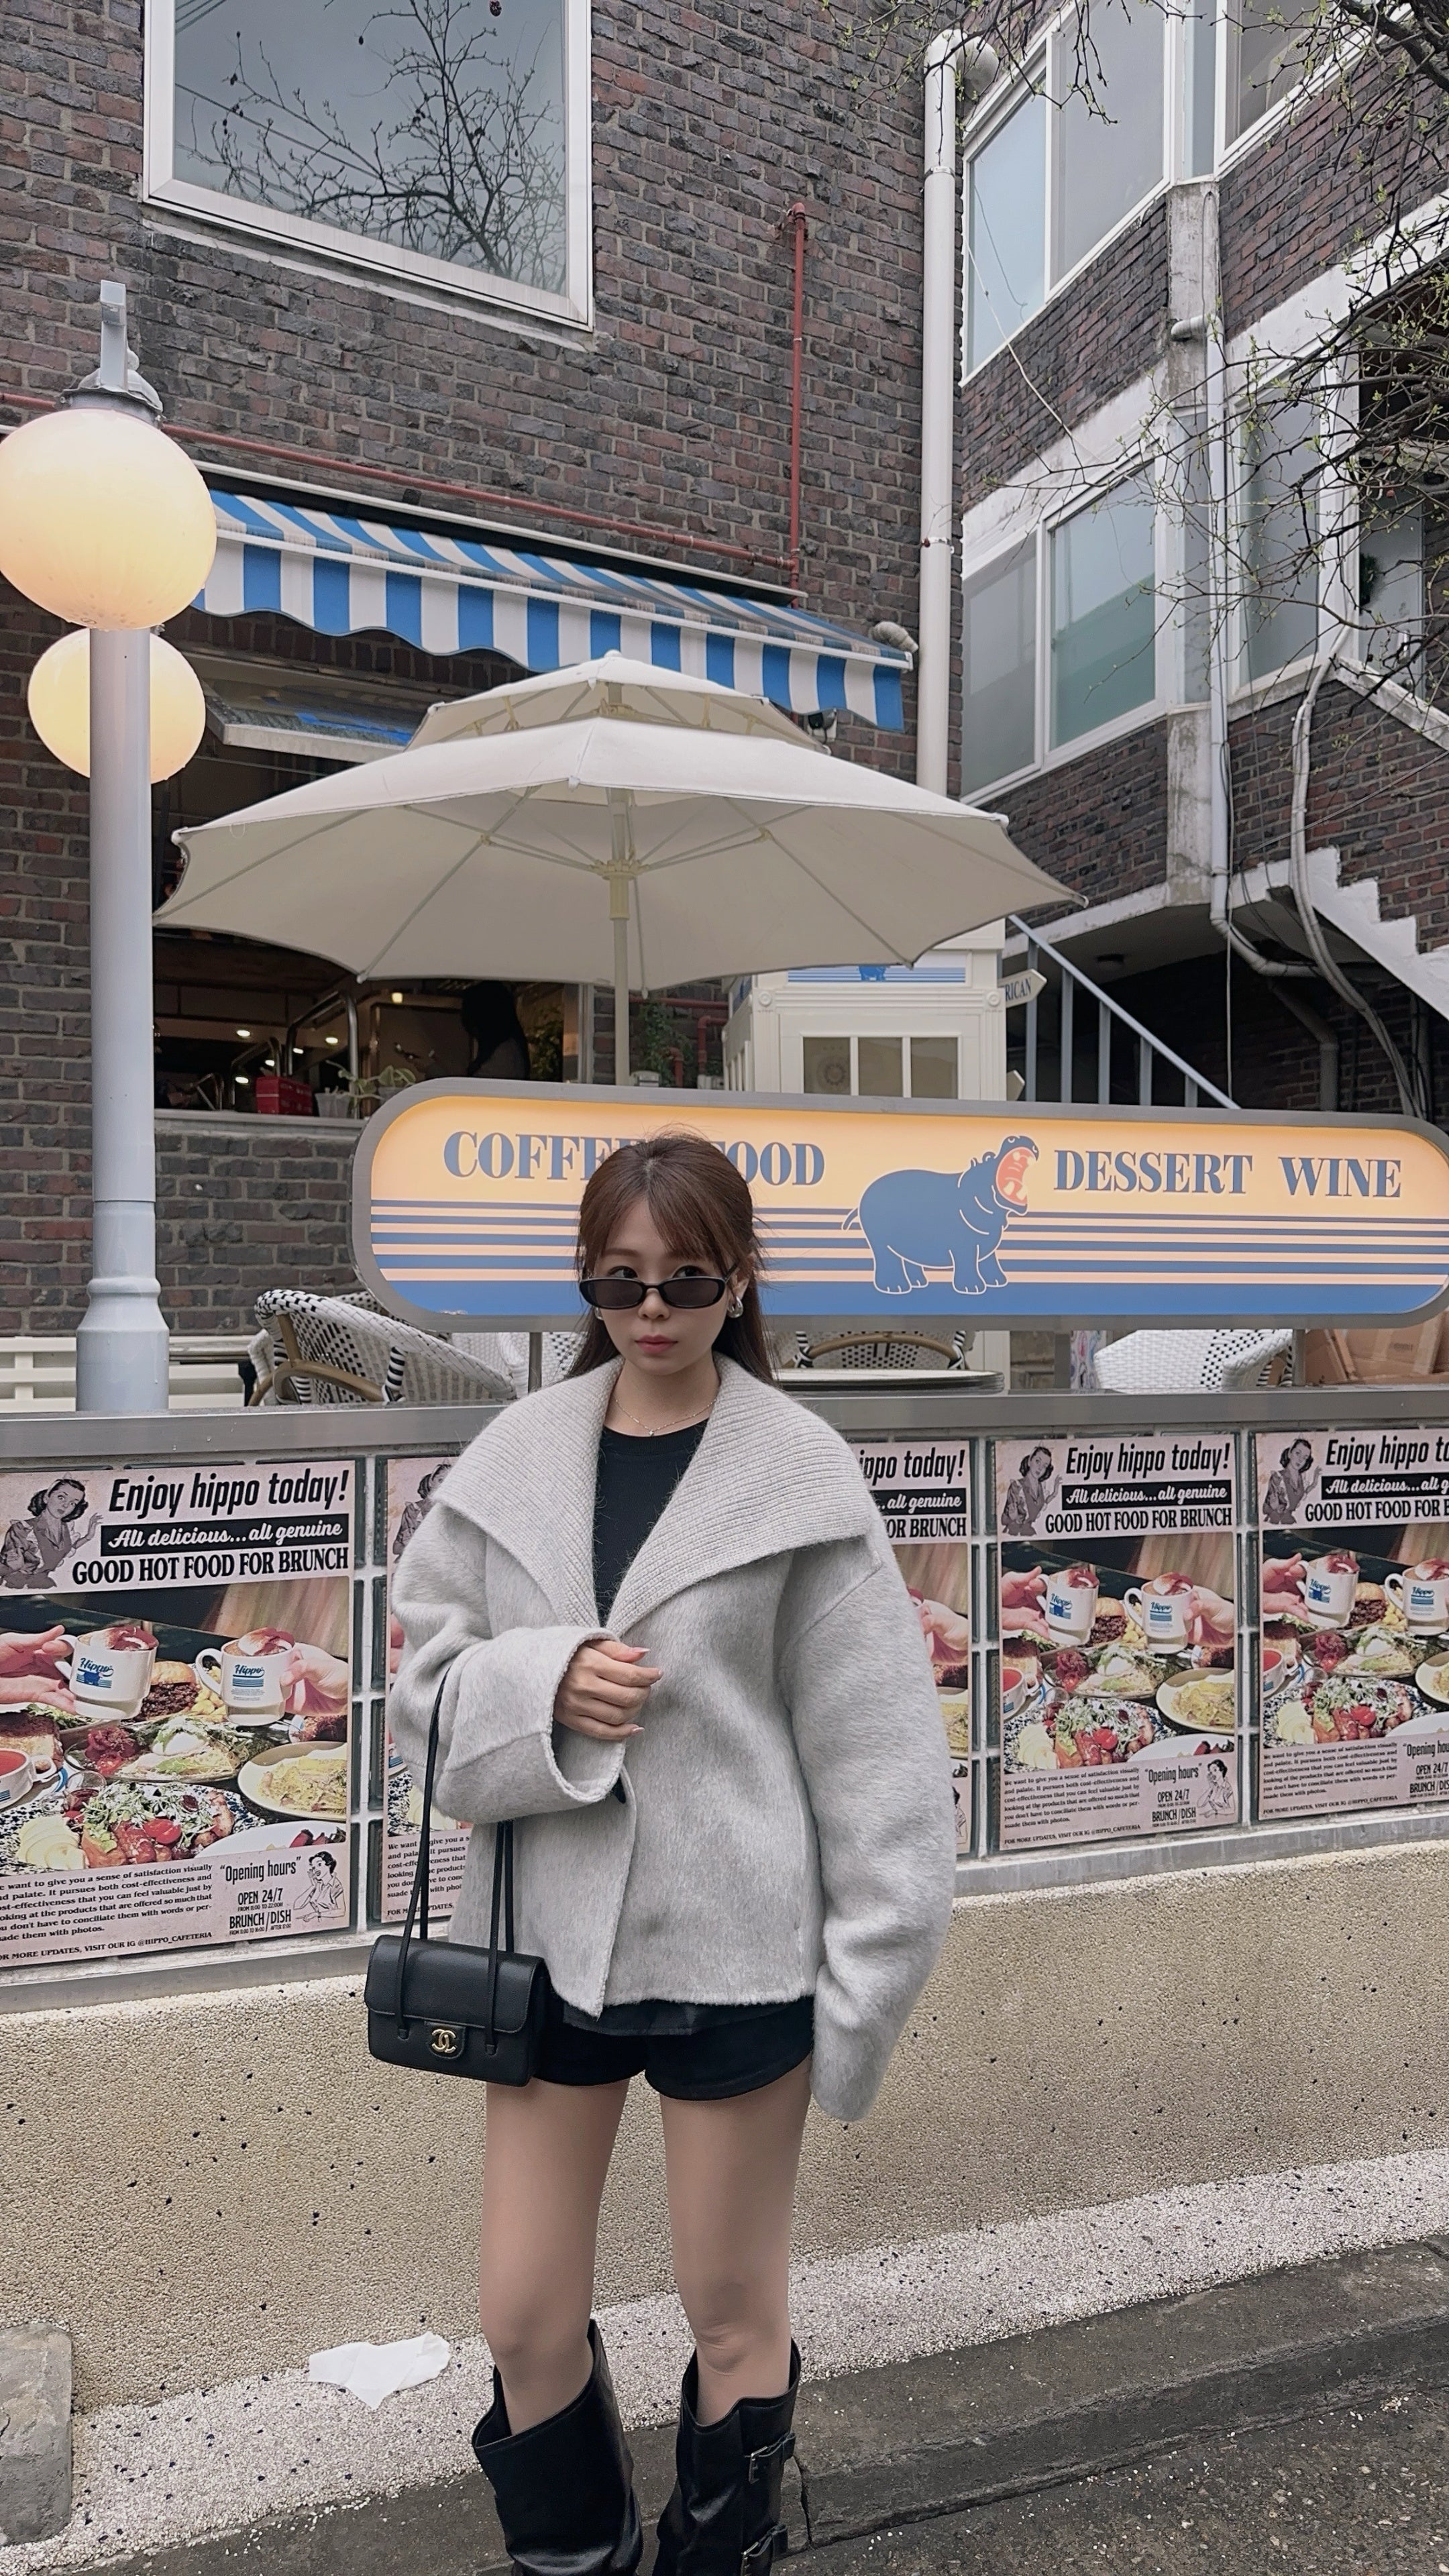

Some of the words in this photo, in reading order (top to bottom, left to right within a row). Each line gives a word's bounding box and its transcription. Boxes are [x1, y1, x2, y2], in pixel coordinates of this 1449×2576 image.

[1005, 977, 1032, 1002] RICAN
[443, 1130, 645, 1181] COFFE
[712, 1140, 825, 1186] OOD
[1054, 1150, 1253, 1194] DESSERT
[1279, 1157, 1401, 1198] WINE
[1066, 1444, 1114, 1480] Enjoy
[1117, 1442, 1165, 1479] hippo
[1172, 1440, 1230, 1477] today!
[1326, 1436, 1375, 1471] Enjoy
[1379, 1435, 1429, 1470] hippo
[904, 1447, 965, 1484] today!
[109, 1476, 184, 1519] Enjoy
[189, 1472, 261, 1516] hippo
[268, 1468, 350, 1509] today!
[1065, 1488, 1089, 1504] All
[1177, 1484, 1228, 1505] genuine
[1326, 1479, 1349, 1494] All
[908, 1493, 962, 1514] genuine
[1305, 1503, 1342, 1522] GOOD
[1346, 1501, 1373, 1520] HOT
[1375, 1500, 1411, 1519] FOOD
[1415, 1499, 1440, 1517] FOR
[884, 1519, 906, 1538] OR
[909, 1517, 967, 1538] BRUNCH
[1045, 1513, 1083, 1533] GOOD
[1085, 1512, 1112, 1532] HOT
[1114, 1511, 1148, 1530] FOOD
[1152, 1509, 1178, 1528] FOR
[1180, 1507, 1232, 1527] BRUNCH
[109, 1529, 146, 1548] All
[275, 1519, 343, 1543] genuine
[72, 1558, 133, 1585] GOOD
[139, 1556, 180, 1581] HOT
[184, 1554, 235, 1579] FOOD
[239, 1551, 274, 1575] FOR
[278, 1547, 349, 1572] BRUNCH
[80, 1658, 112, 1673] Hippo
[235, 1664, 264, 1676] Hippo
[1416, 1764, 1431, 1775] OPEN
[1158, 1791, 1173, 1803] OPEN
[1175, 1788, 1189, 1801] 24/7
[404, 1850, 419, 1859] pala
[438, 1846, 466, 1855] pursues
[48, 1879, 66, 1887] give
[134, 1868, 181, 1877] satisfaction
[13, 1892, 46, 1900] palate.
[60, 1888, 95, 1896] pursues
[152, 1887, 184, 1895] valuable
[186, 1885, 200, 1893] just
[237, 1890, 258, 1905] OPEN
[262, 1887, 283, 1903] 24/7
[387, 1890, 408, 1898] suade
[58, 1907, 97, 1917] products
[134, 1899, 162, 1907] offered
[73, 1915, 115, 1923] conciliate
[72, 1927, 104, 1935] photos.
[41, 1947, 82, 1955] UPDATES,
